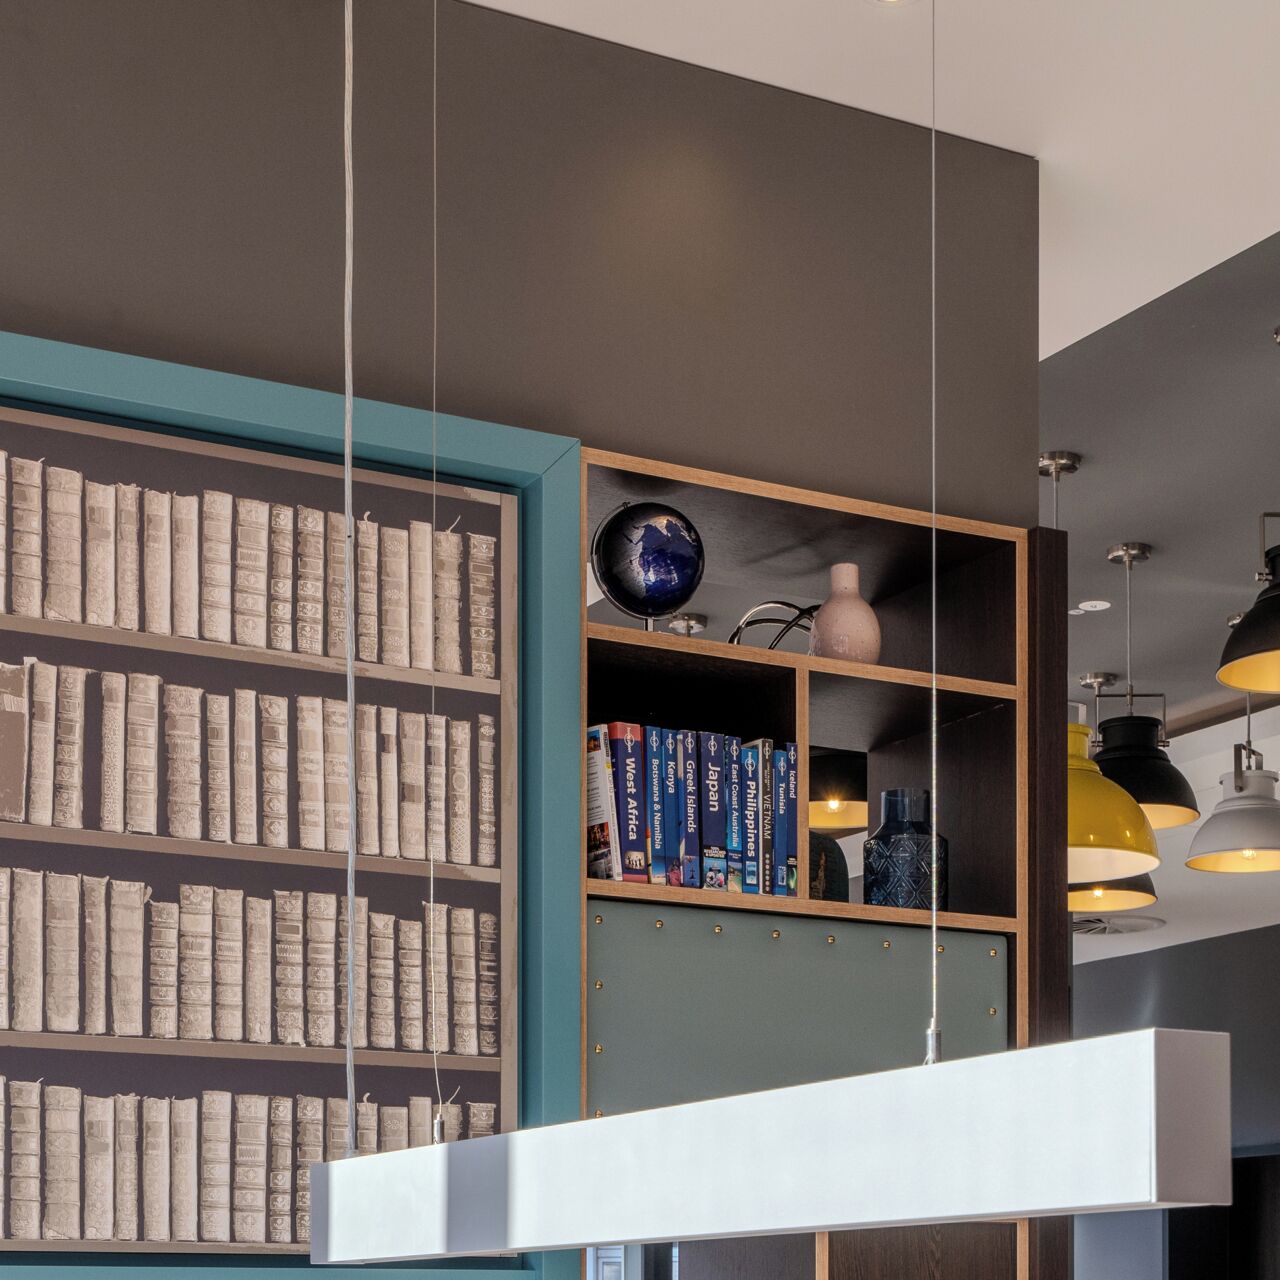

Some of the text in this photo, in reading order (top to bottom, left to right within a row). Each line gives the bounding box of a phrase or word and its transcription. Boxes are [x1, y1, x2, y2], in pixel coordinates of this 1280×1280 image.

[625, 757, 636, 794] West
[651, 758, 660, 802] Botswana
[665, 760, 676, 794] Kenya
[705, 762, 721, 812] Japan
[731, 763, 739, 783] East
[789, 770, 797, 799] Iceland
[653, 802, 661, 811] &
[686, 760, 697, 833] Greek Islands
[731, 784, 739, 812] Coast
[778, 782, 787, 815] Tunisia
[627, 798, 639, 841] Africa
[654, 811, 665, 850] Namibia
[731, 812, 740, 848] Australia
[745, 780, 757, 858] Philippines
[763, 794, 772, 840] VIETNAM
